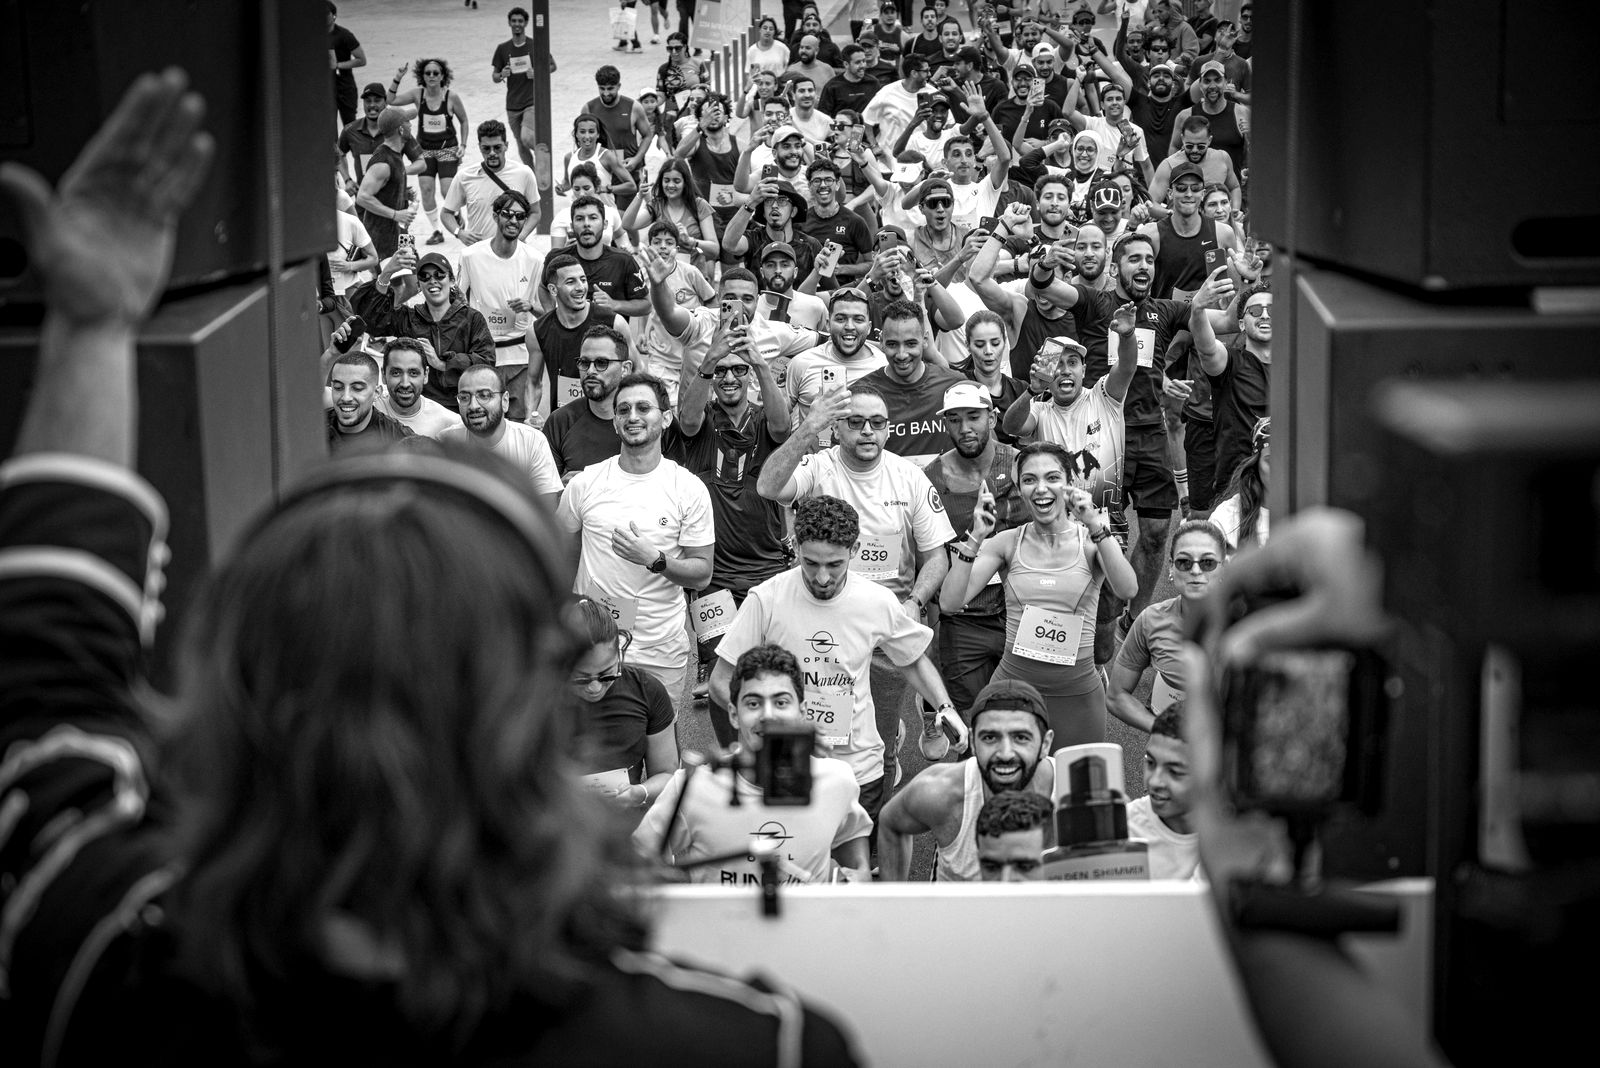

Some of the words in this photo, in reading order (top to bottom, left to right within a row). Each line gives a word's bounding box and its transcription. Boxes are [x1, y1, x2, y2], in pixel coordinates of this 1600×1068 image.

[835, 225, 846, 233] UR
[488, 315, 507, 324] 1651
[1146, 311, 1159, 321] UR
[568, 388, 583, 398] 101
[887, 423, 906, 438] FG
[860, 549, 888, 562] 839
[699, 605, 724, 622] 905
[1034, 625, 1067, 643] 946
[803, 656, 840, 664] OPEL
[806, 708, 835, 724] 878
[747, 853, 794, 862] OL
